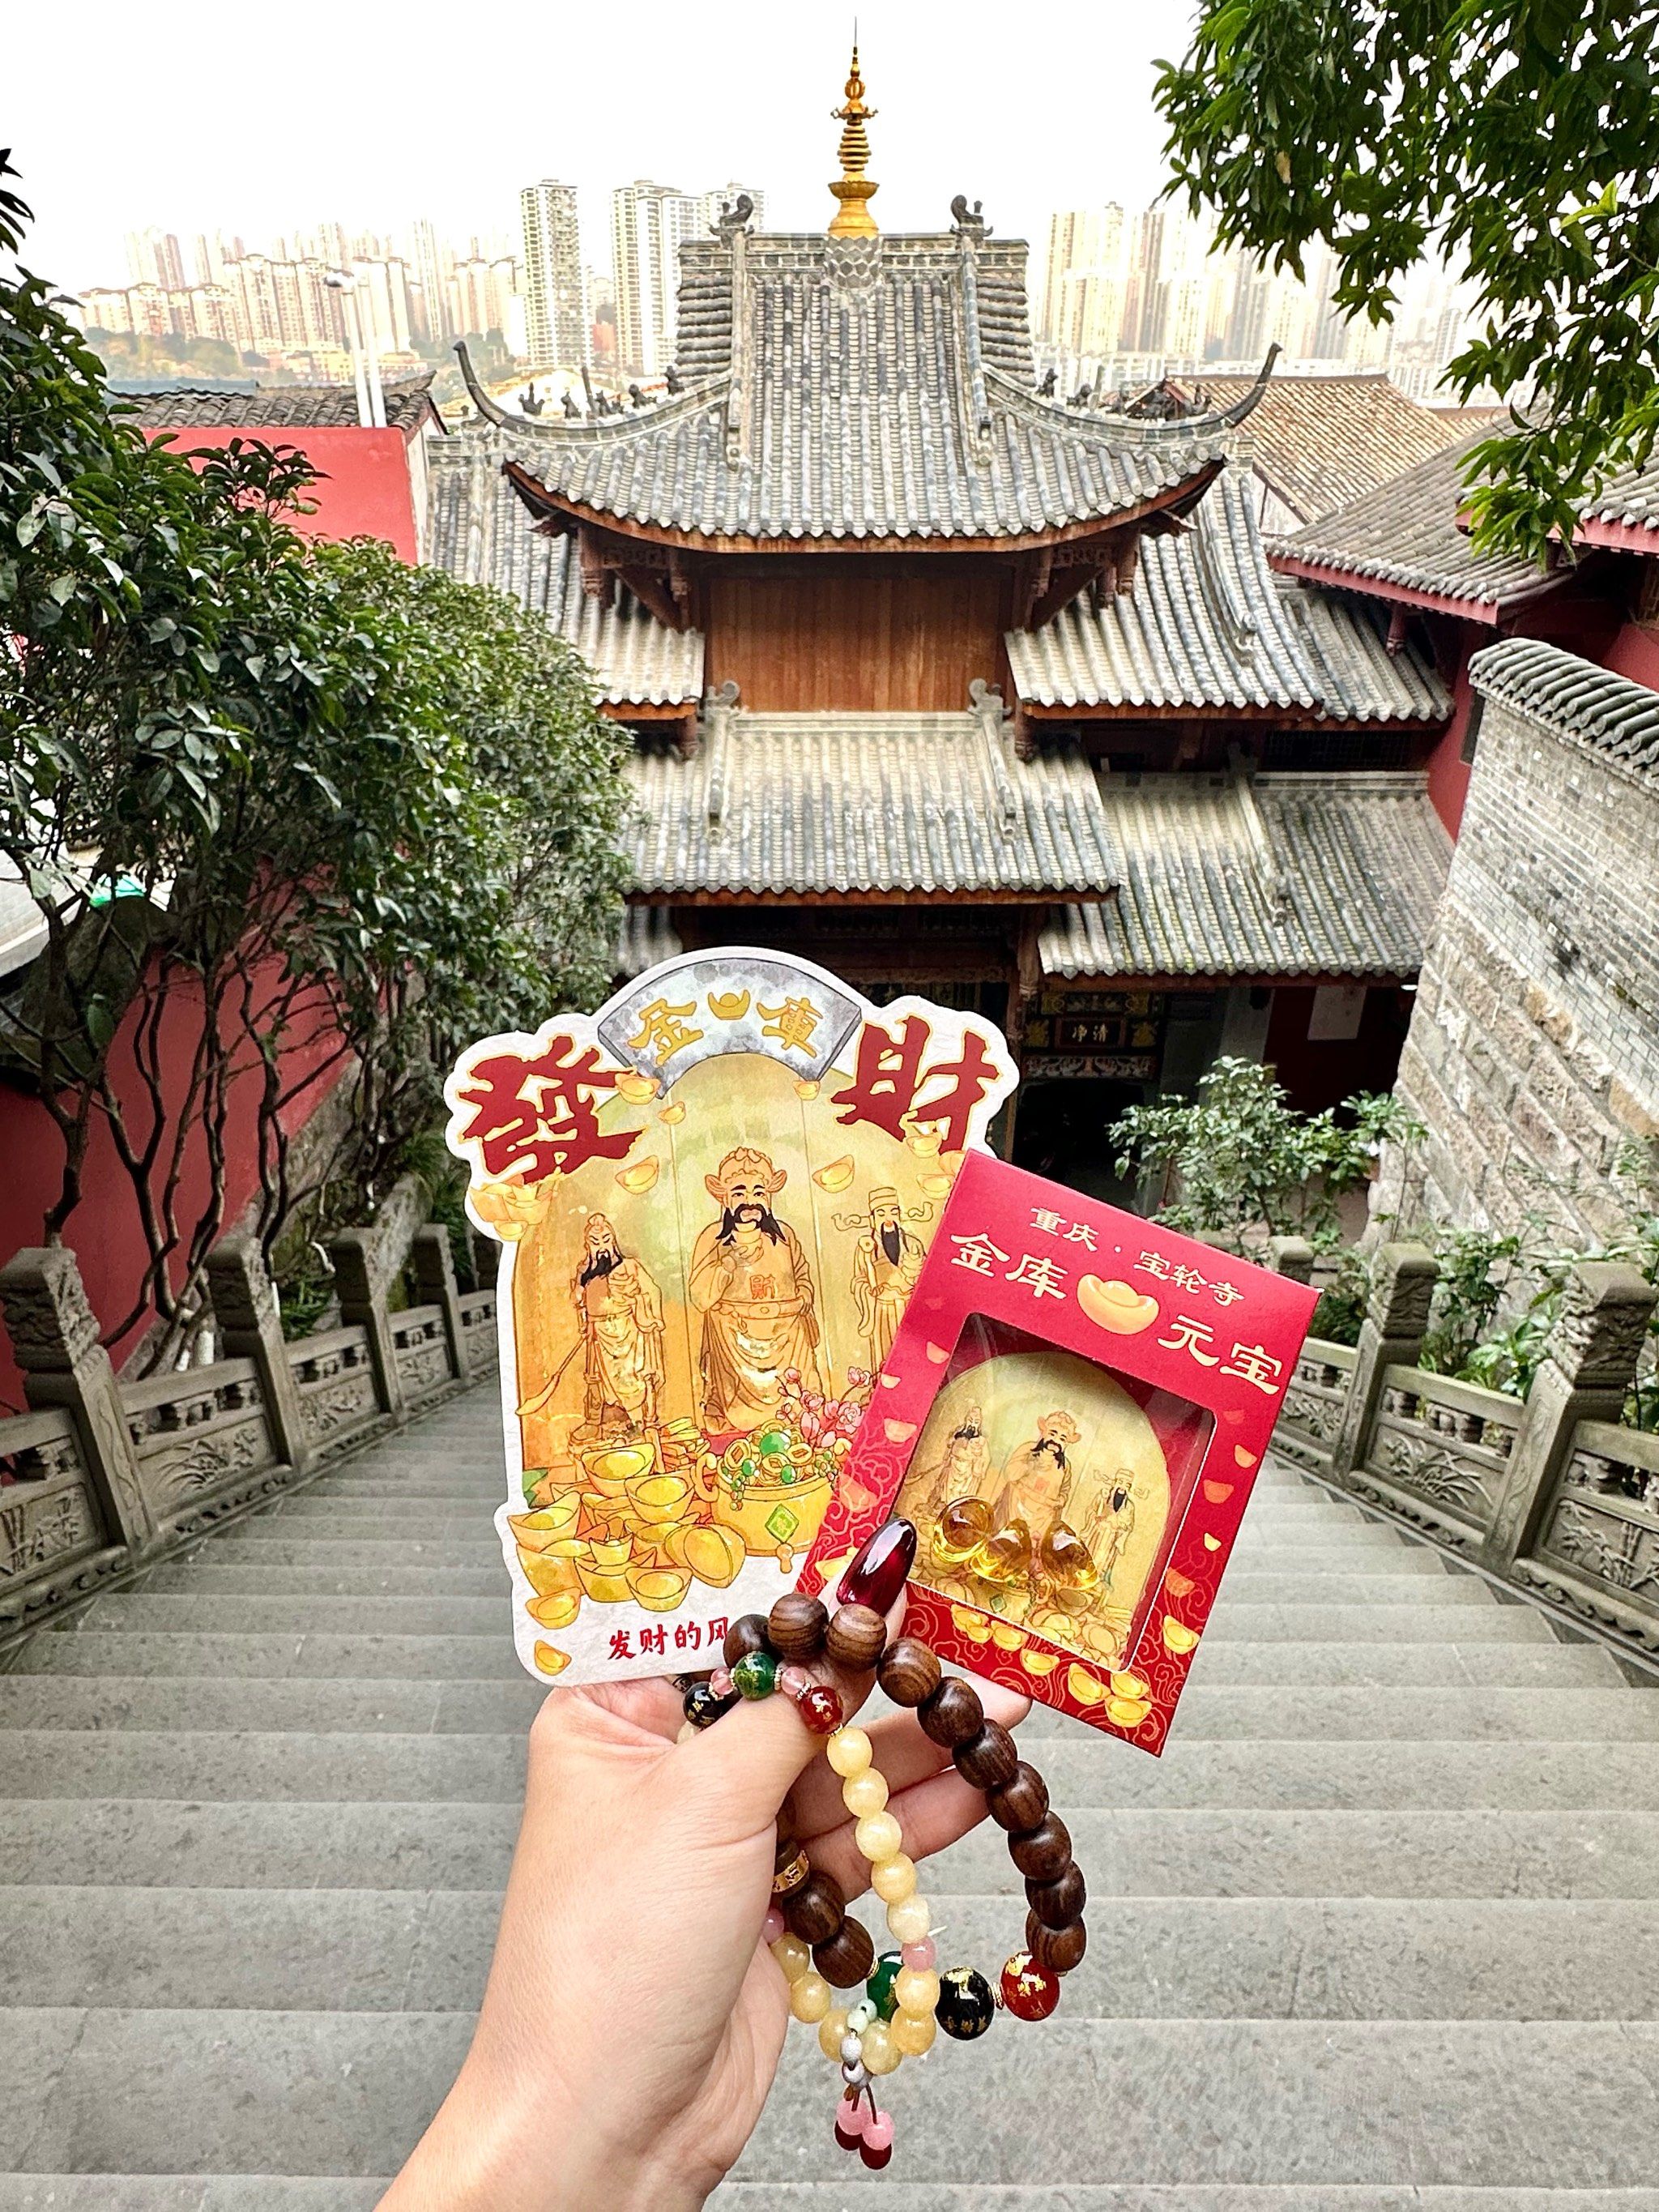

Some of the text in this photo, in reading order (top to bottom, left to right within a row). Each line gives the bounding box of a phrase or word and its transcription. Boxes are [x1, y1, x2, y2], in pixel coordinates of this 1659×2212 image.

[627, 997, 704, 1066] 金
[830, 1015, 1001, 1152] 財
[949, 1233, 1282, 1395] 金库 元宝
[608, 1616, 729, 1660] 发财的风
